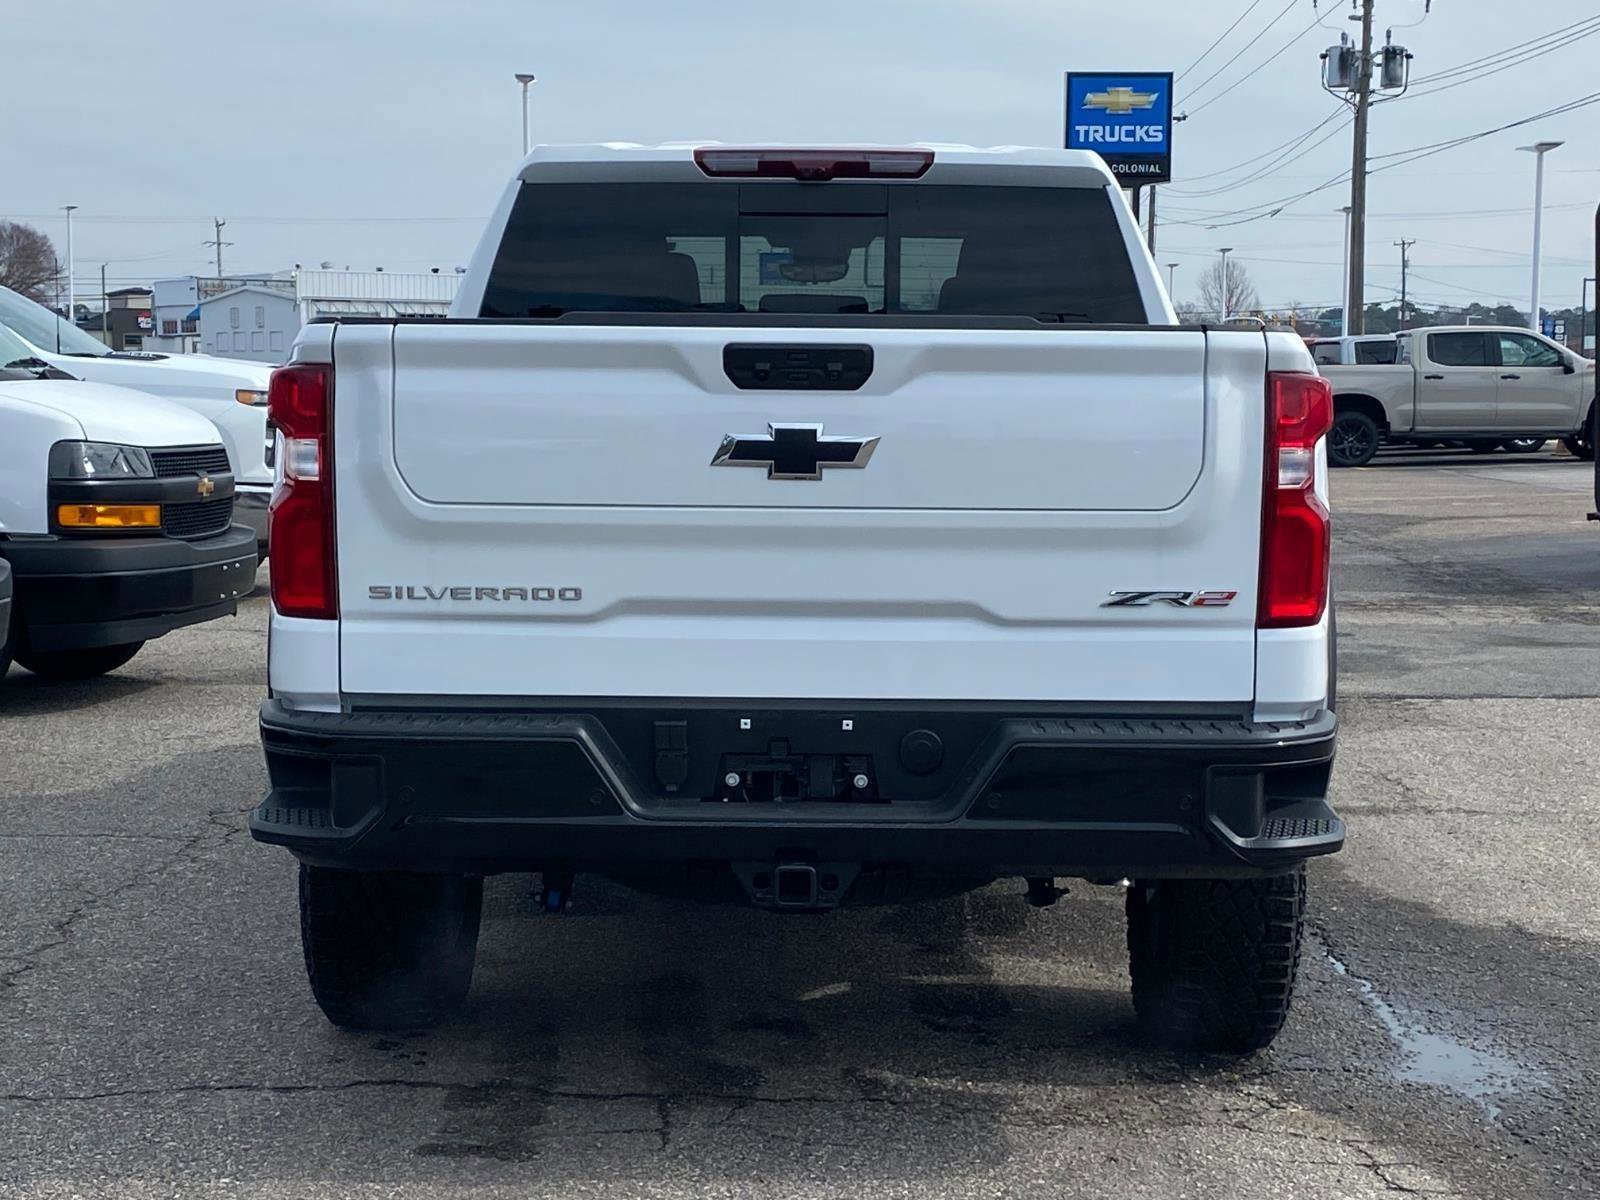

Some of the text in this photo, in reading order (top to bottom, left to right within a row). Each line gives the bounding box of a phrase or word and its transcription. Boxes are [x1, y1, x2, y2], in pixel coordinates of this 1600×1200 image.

[1075, 125, 1163, 142] TRUCKS
[1112, 164, 1161, 173] COLONIAL
[368, 585, 582, 602] SILVERADO
[1099, 590, 1238, 608] ZR2
